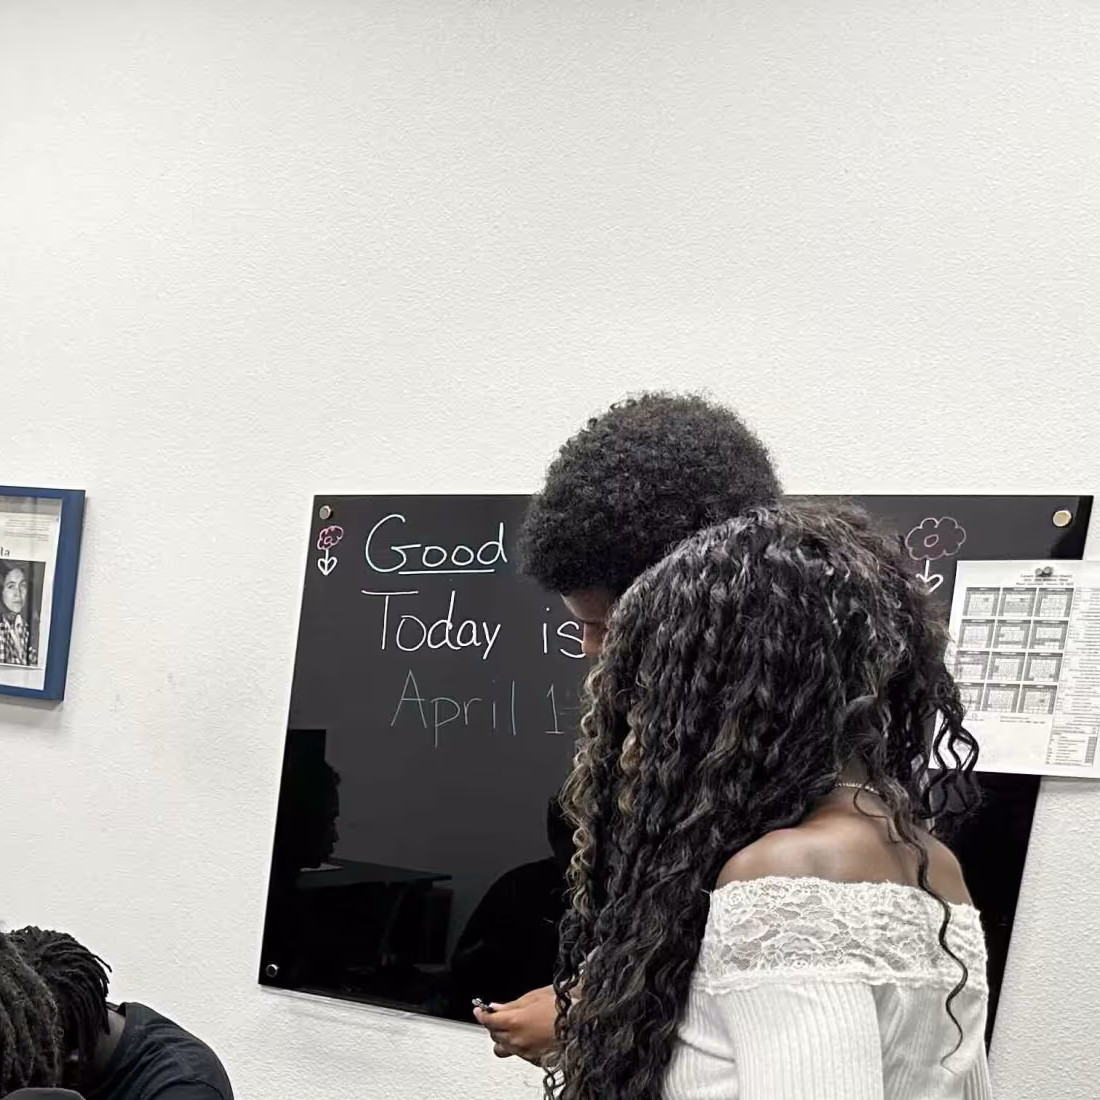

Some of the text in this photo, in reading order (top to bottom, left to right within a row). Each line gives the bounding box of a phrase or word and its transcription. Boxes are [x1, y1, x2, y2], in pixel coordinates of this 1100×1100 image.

[365, 513, 508, 573] Good
[361, 590, 586, 660] Today is
[390, 669, 516, 748] April
